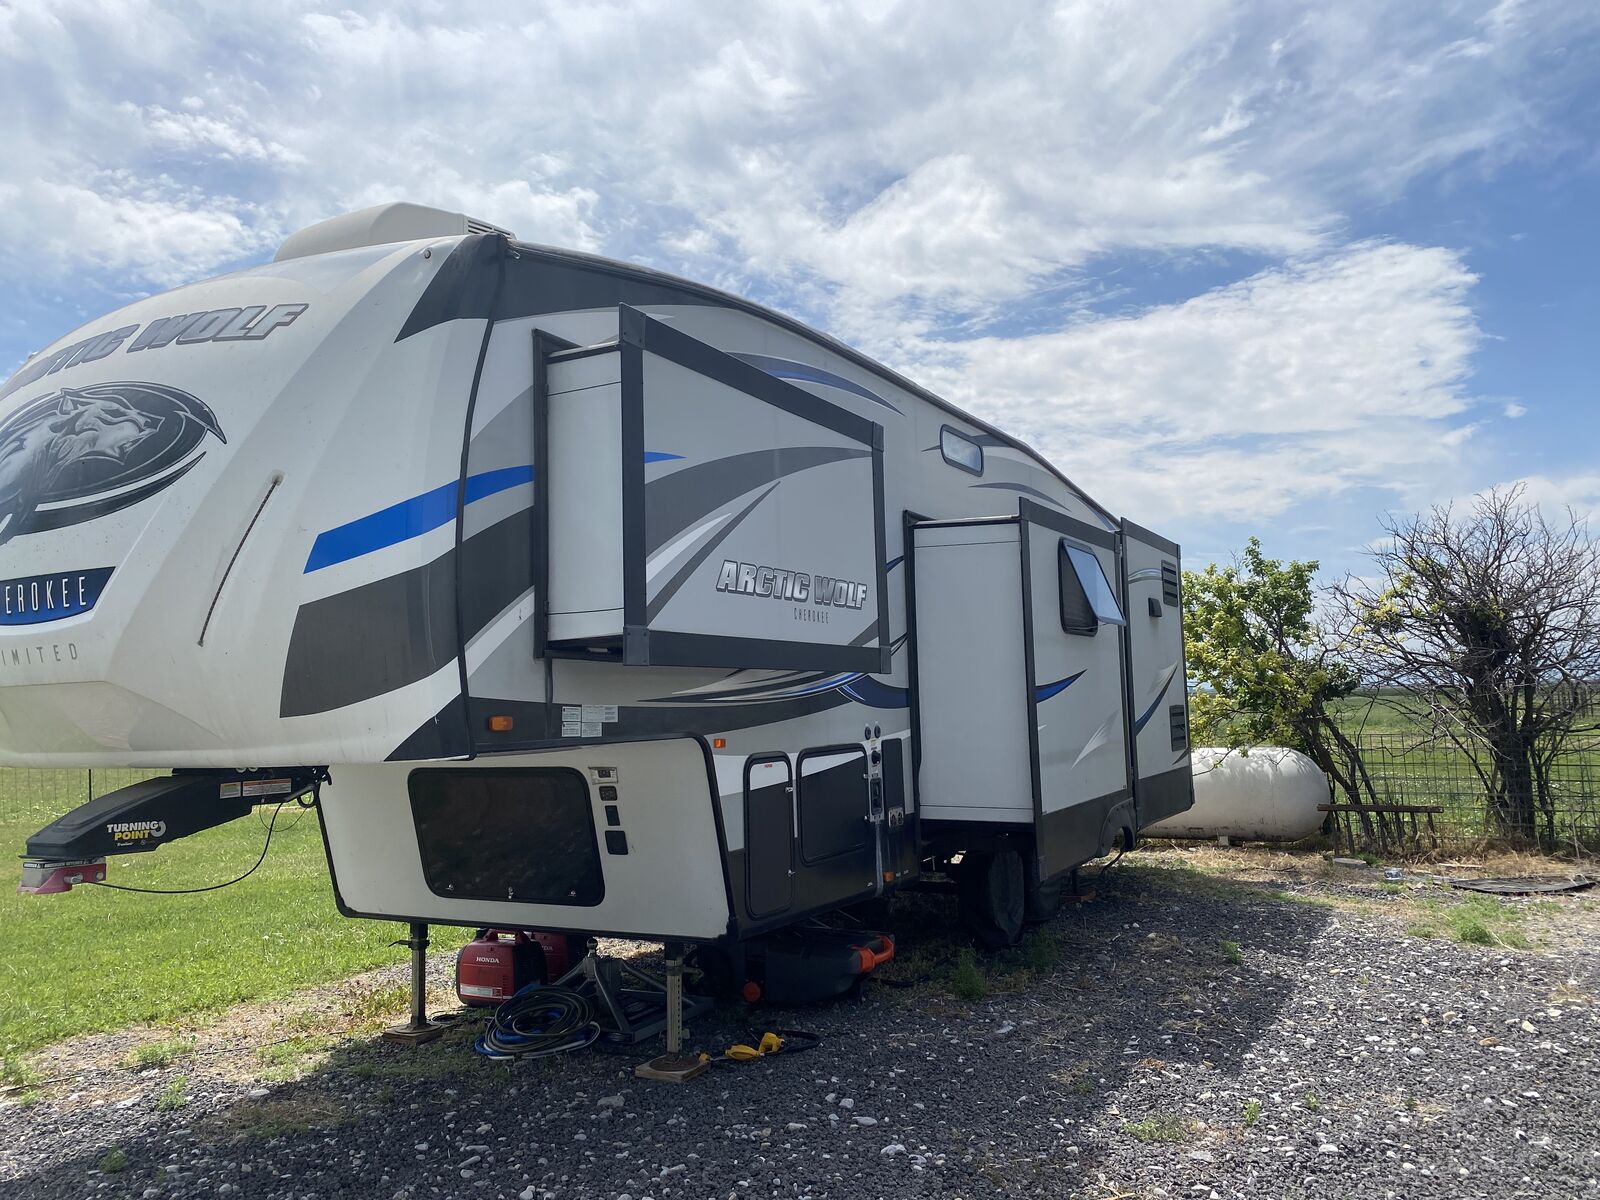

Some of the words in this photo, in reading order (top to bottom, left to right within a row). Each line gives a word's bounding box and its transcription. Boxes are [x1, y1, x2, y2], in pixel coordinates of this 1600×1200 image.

[126, 303, 309, 353] WOLF
[716, 559, 810, 603] ARCTIC
[814, 575, 867, 610] WOLF
[5, 576, 87, 615] EROKEE
[794, 607, 829, 624] CHEROKEE
[1, 642, 78, 666] IMITED
[106, 820, 159, 833] TURNING
[114, 830, 151, 841] POINT
[475, 956, 500, 964] HONDA
